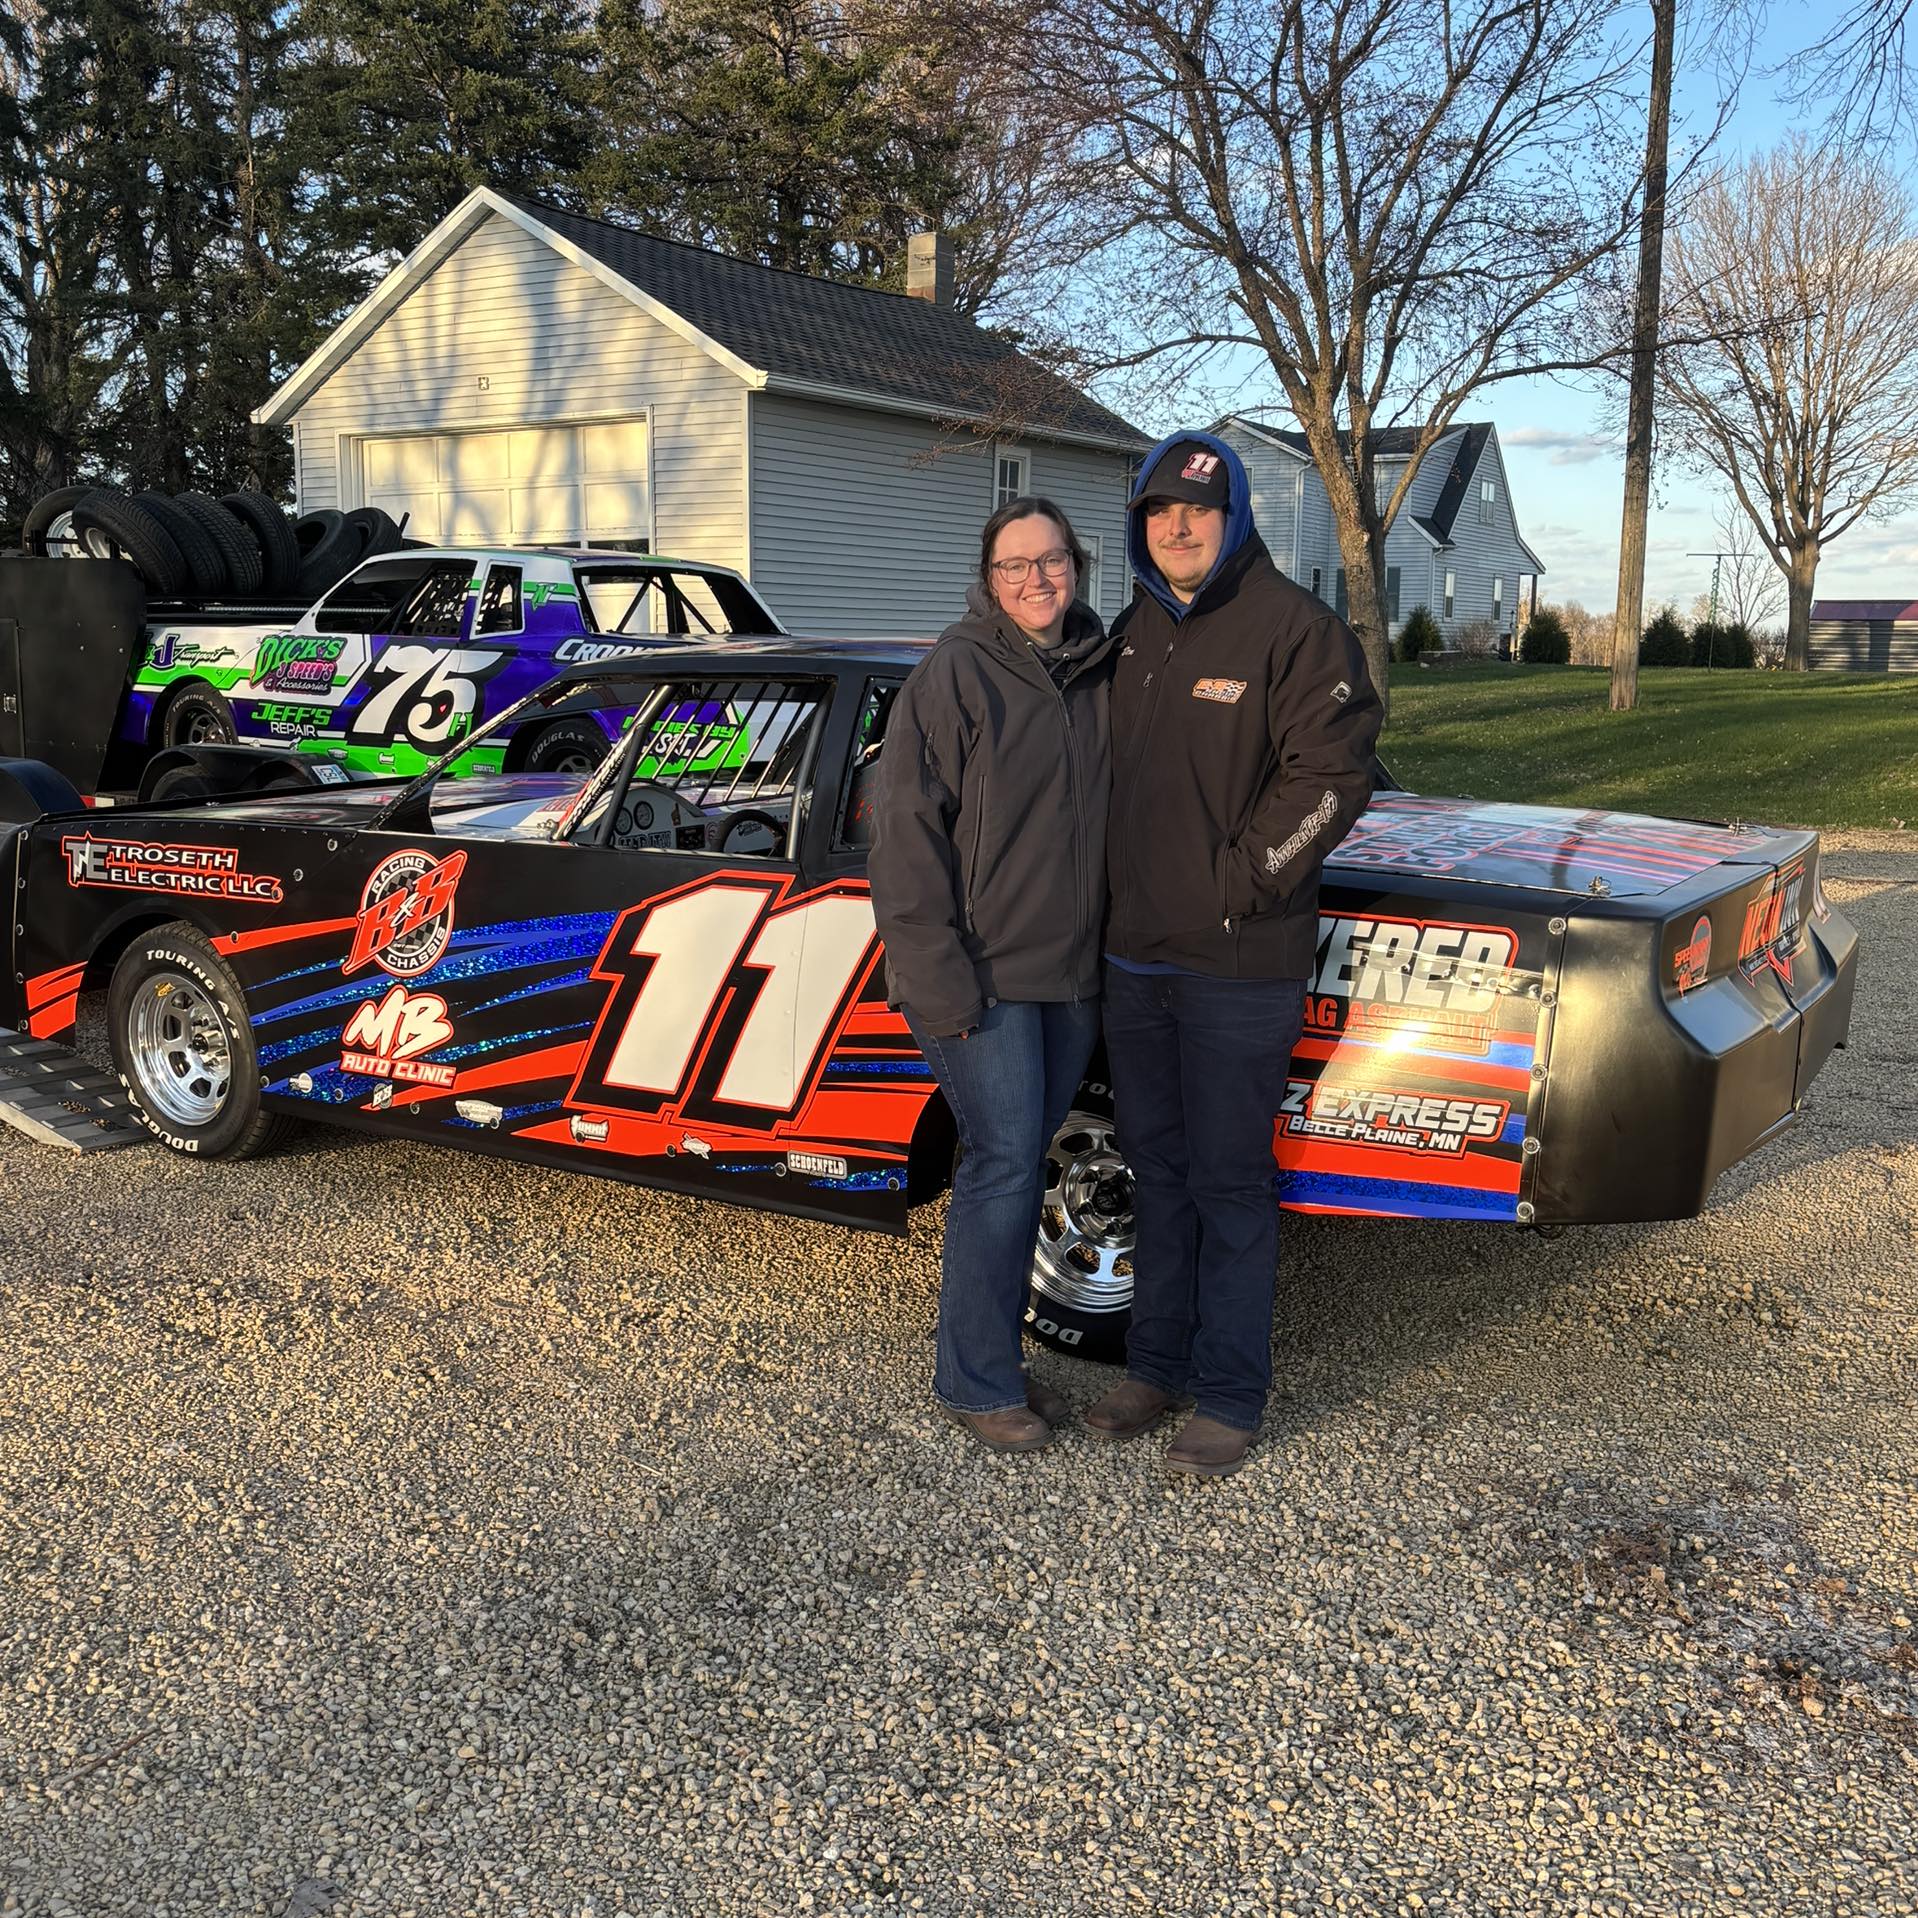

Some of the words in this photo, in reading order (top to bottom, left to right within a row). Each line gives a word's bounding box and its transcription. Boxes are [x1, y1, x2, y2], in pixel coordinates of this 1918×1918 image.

[1188, 453, 1219, 474] 11
[252, 637, 345, 684] DICK'S
[276, 677, 329, 691] Accessories
[353, 645, 503, 743] 75
[252, 703, 333, 725] JEFF'S
[270, 721, 316, 737] REPAIR
[531, 731, 585, 763] DOUGLAS
[111, 845, 234, 868] TROSETH
[110, 868, 221, 892] ELECTRIC
[228, 878, 273, 896] LLC
[371, 856, 426, 894] RACING
[387, 926, 446, 968] CHASSIS
[146, 949, 215, 991] TOURING
[218, 1000, 241, 1040] A/S
[602, 884, 878, 1112] 11
[345, 988, 451, 1059] MB
[341, 1053, 391, 1076] AUTO
[393, 1061, 456, 1085] CLINIC
[119, 1072, 199, 1152] DOUGLAS
[1313, 1085, 1502, 1136] EXPRESS
[1428, 1133, 1463, 1151] MN
[789, 1153, 845, 1176] SCHOENFELD
